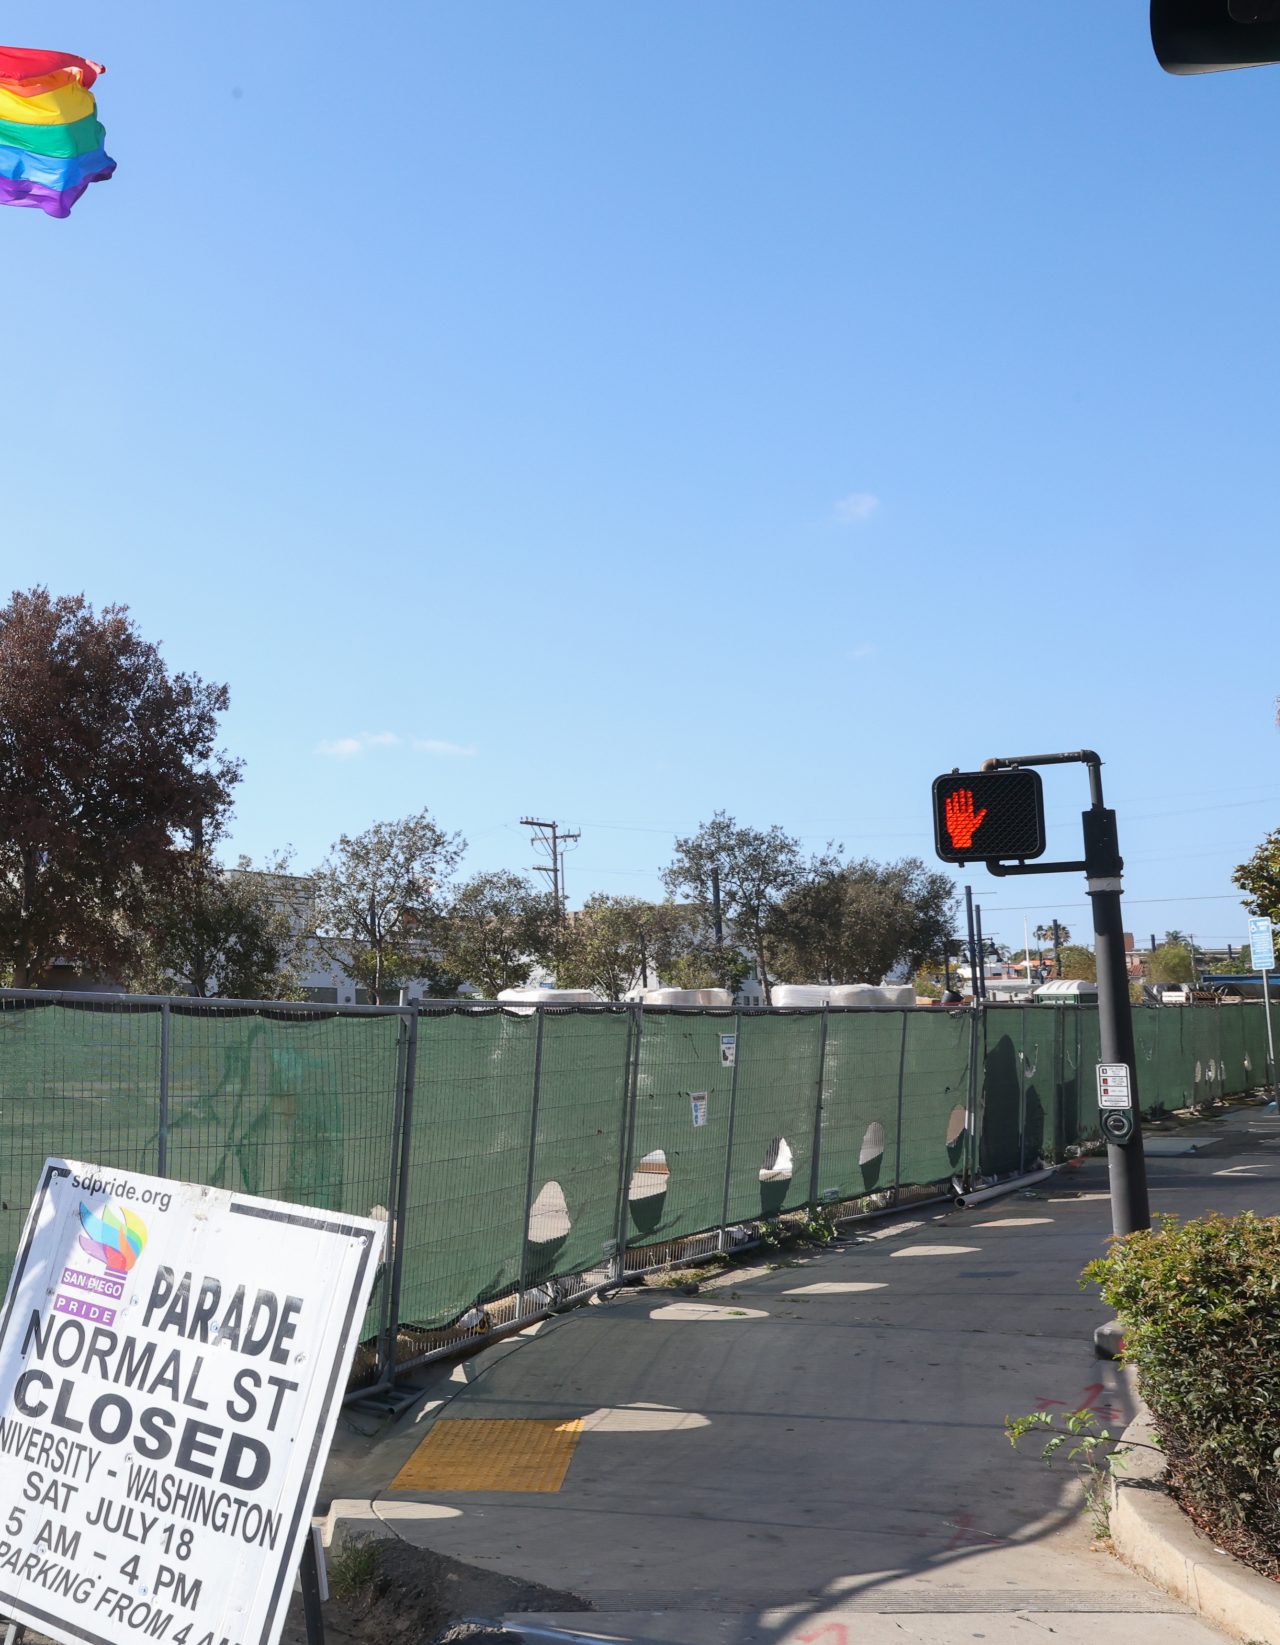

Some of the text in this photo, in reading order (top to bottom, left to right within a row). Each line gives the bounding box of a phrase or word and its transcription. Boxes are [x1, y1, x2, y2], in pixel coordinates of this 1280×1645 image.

[71, 1174, 173, 1213] sdpride.org
[56, 1297, 113, 1323] PRIDE
[63, 1270, 122, 1296] SAN DIEGO
[141, 1264, 304, 1366] PARADE
[21, 1308, 298, 1432] NORMAL ST
[13, 1369, 271, 1491] CLOSED
[23, 1471, 194, 1561] SAT JULY 18
[126, 1464, 283, 1551] WASHINGTON
[5, 1506, 26, 1536] 5
[33, 1519, 82, 1561] AM
[119, 1554, 141, 1585] 4
[152, 1564, 203, 1611] PM
[93, 1586, 174, 1640] FROM
[172, 1622, 194, 1645] 4
[196, 1631, 242, 1645] A
